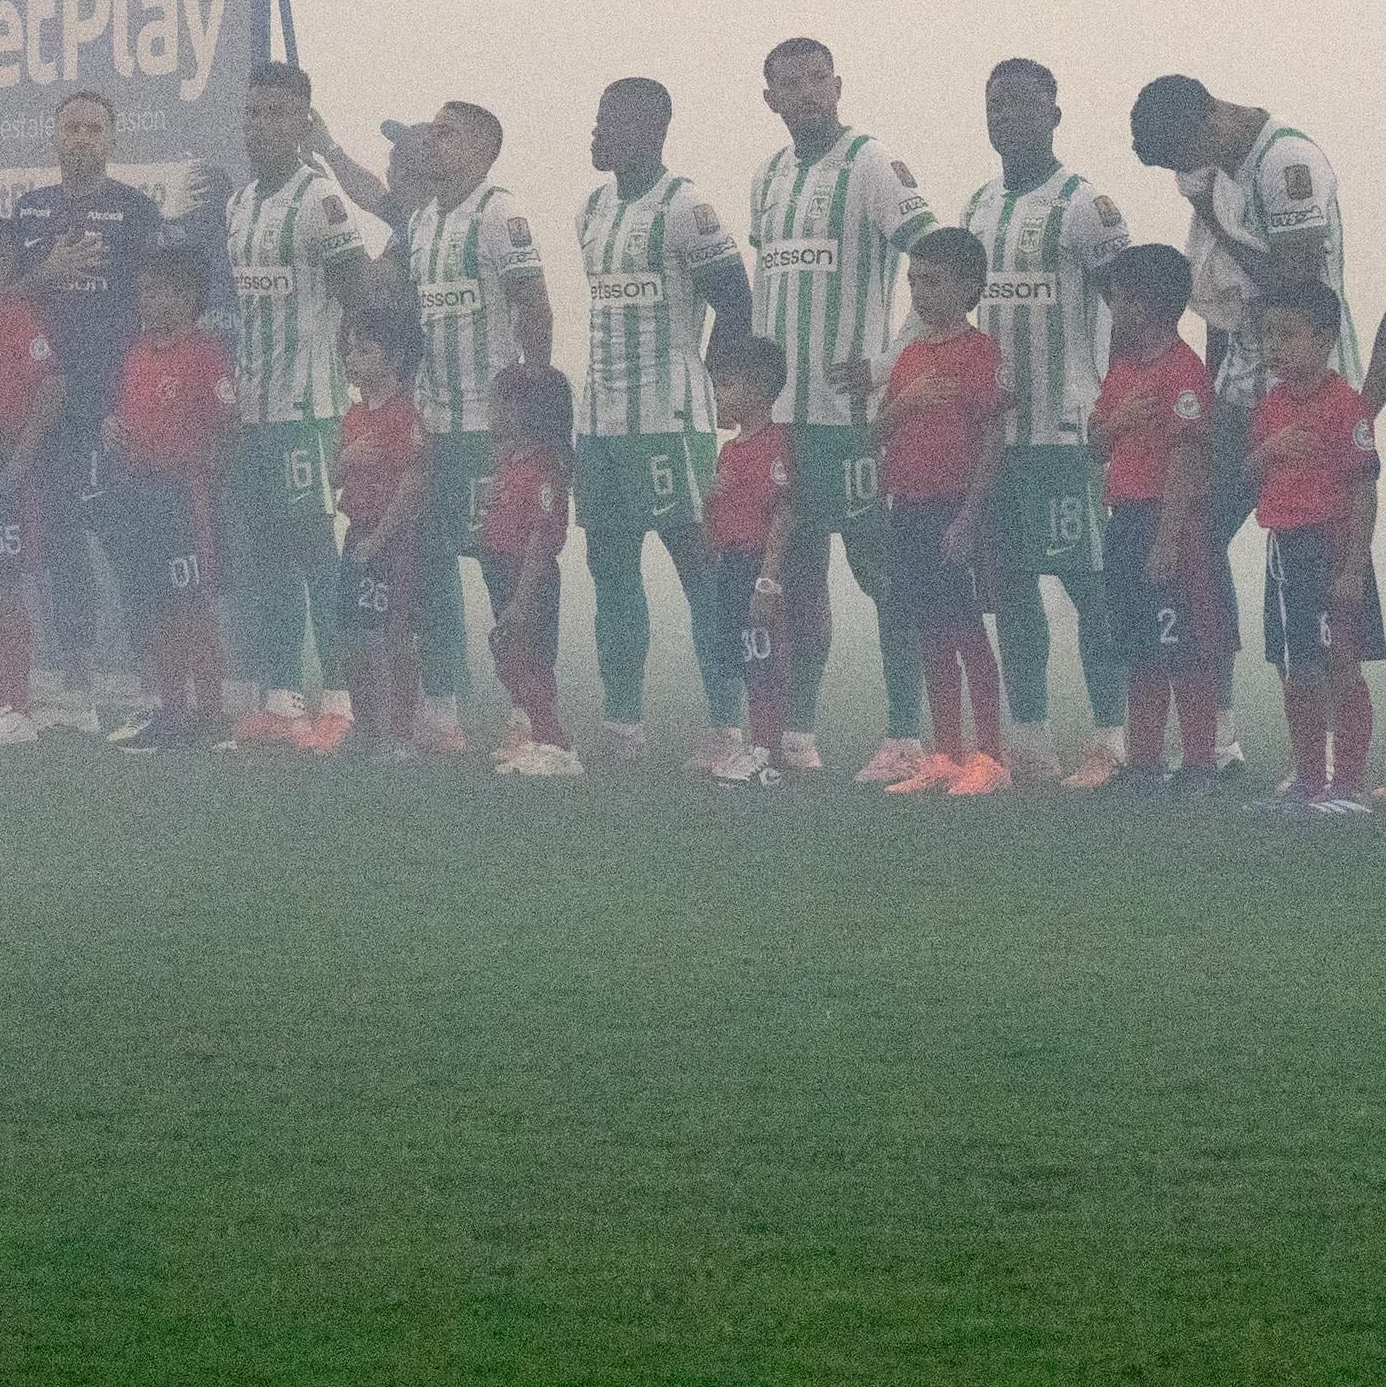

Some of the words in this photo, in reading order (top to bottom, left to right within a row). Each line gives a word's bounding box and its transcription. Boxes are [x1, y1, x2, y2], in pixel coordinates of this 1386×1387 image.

[239, 273, 290, 291] tsson
[420, 288, 477, 309] tsson
[590, 279, 659, 300] etsson
[982, 280, 1051, 299] tsson
[284, 449, 313, 489] 16
[651, 454, 673, 496] 6
[843, 457, 877, 500] 10
[1049, 496, 1082, 542] 18
[170, 554, 200, 588] 01
[358, 577, 390, 612] 26
[1157, 608, 1179, 643] 2
